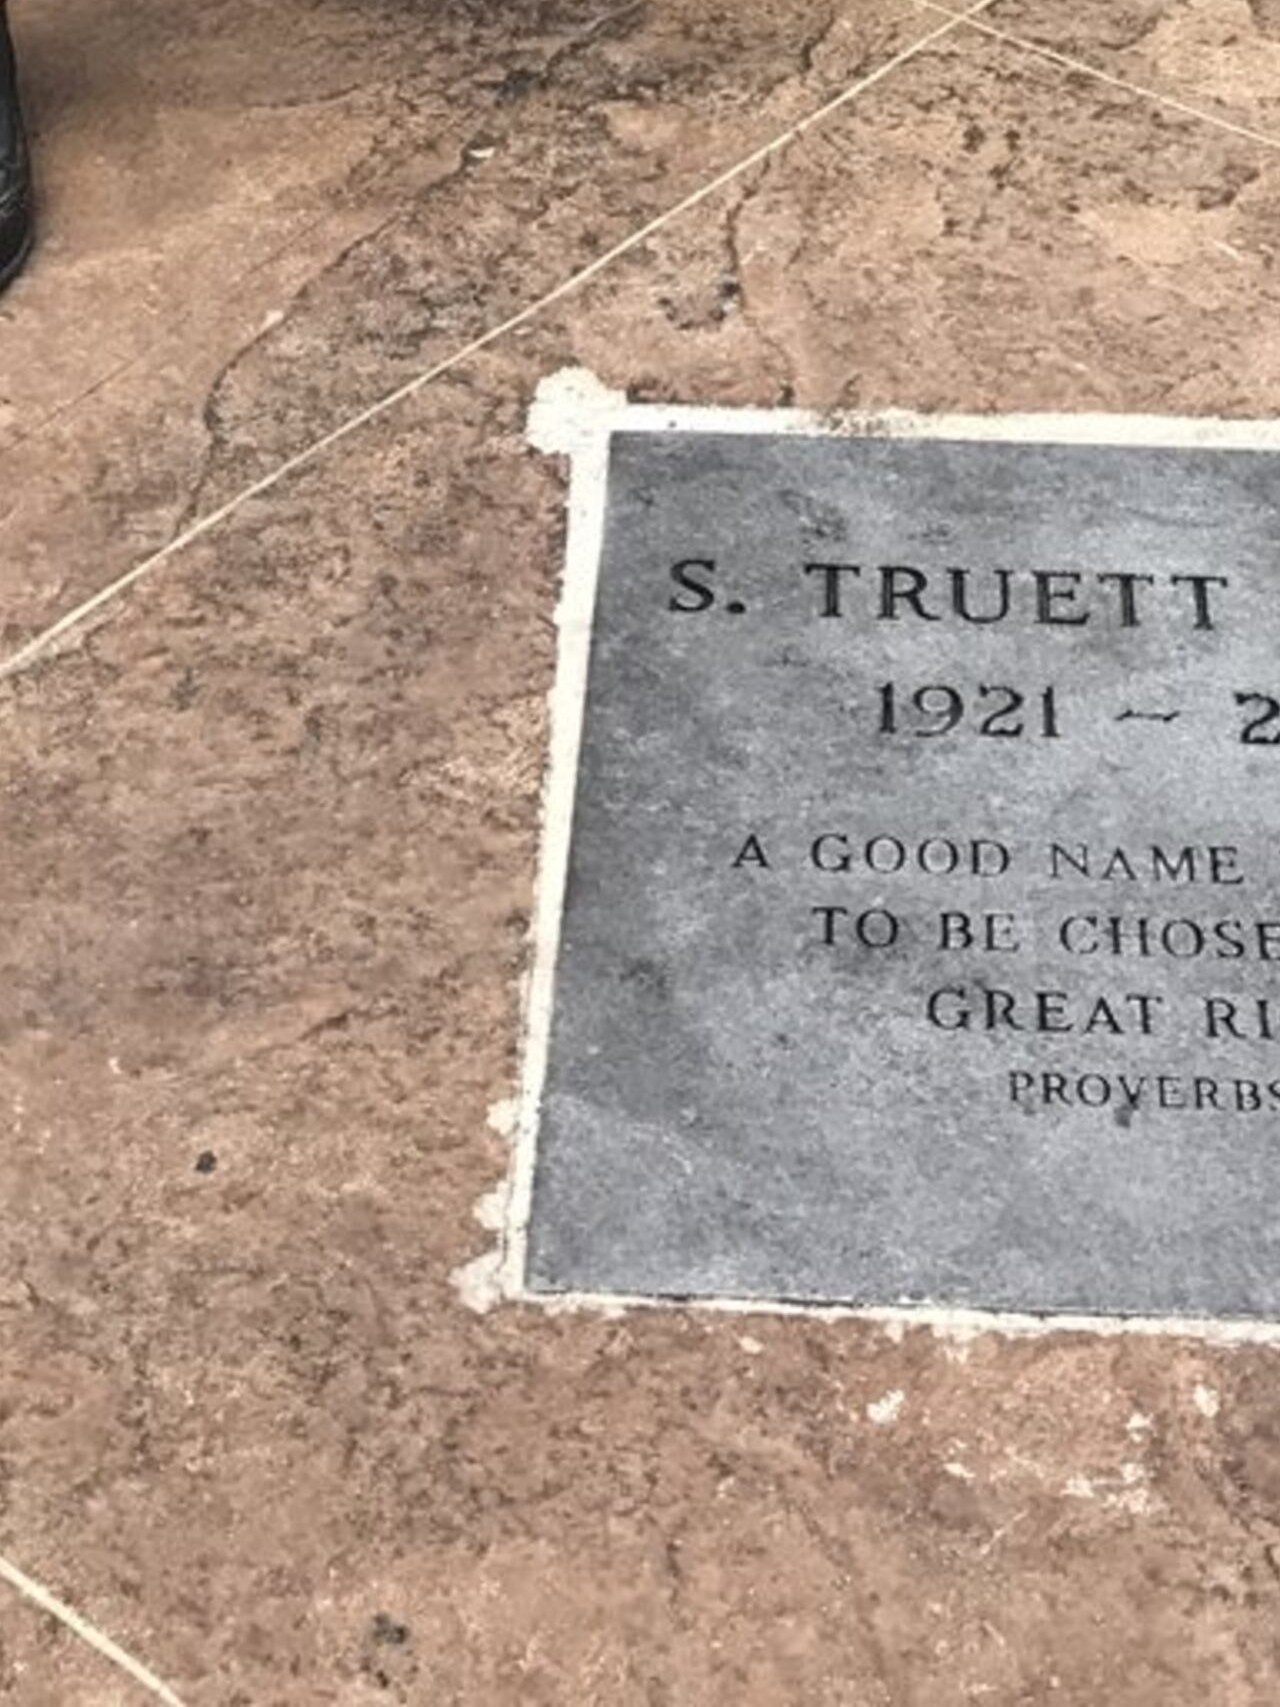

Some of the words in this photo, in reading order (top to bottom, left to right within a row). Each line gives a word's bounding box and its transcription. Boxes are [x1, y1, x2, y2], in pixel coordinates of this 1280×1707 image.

[668, 559, 747, 615] S.
[804, 562, 1228, 631] TRUETT
[877, 682, 1061, 739] 1921
[731, 833, 769, 869] A
[810, 832, 1011, 878] GOOD
[1048, 843, 1245, 886] NAME
[812, 905, 899, 949] TO
[938, 911, 1019, 952] BE
[926, 987, 1164, 1035] GREAT
